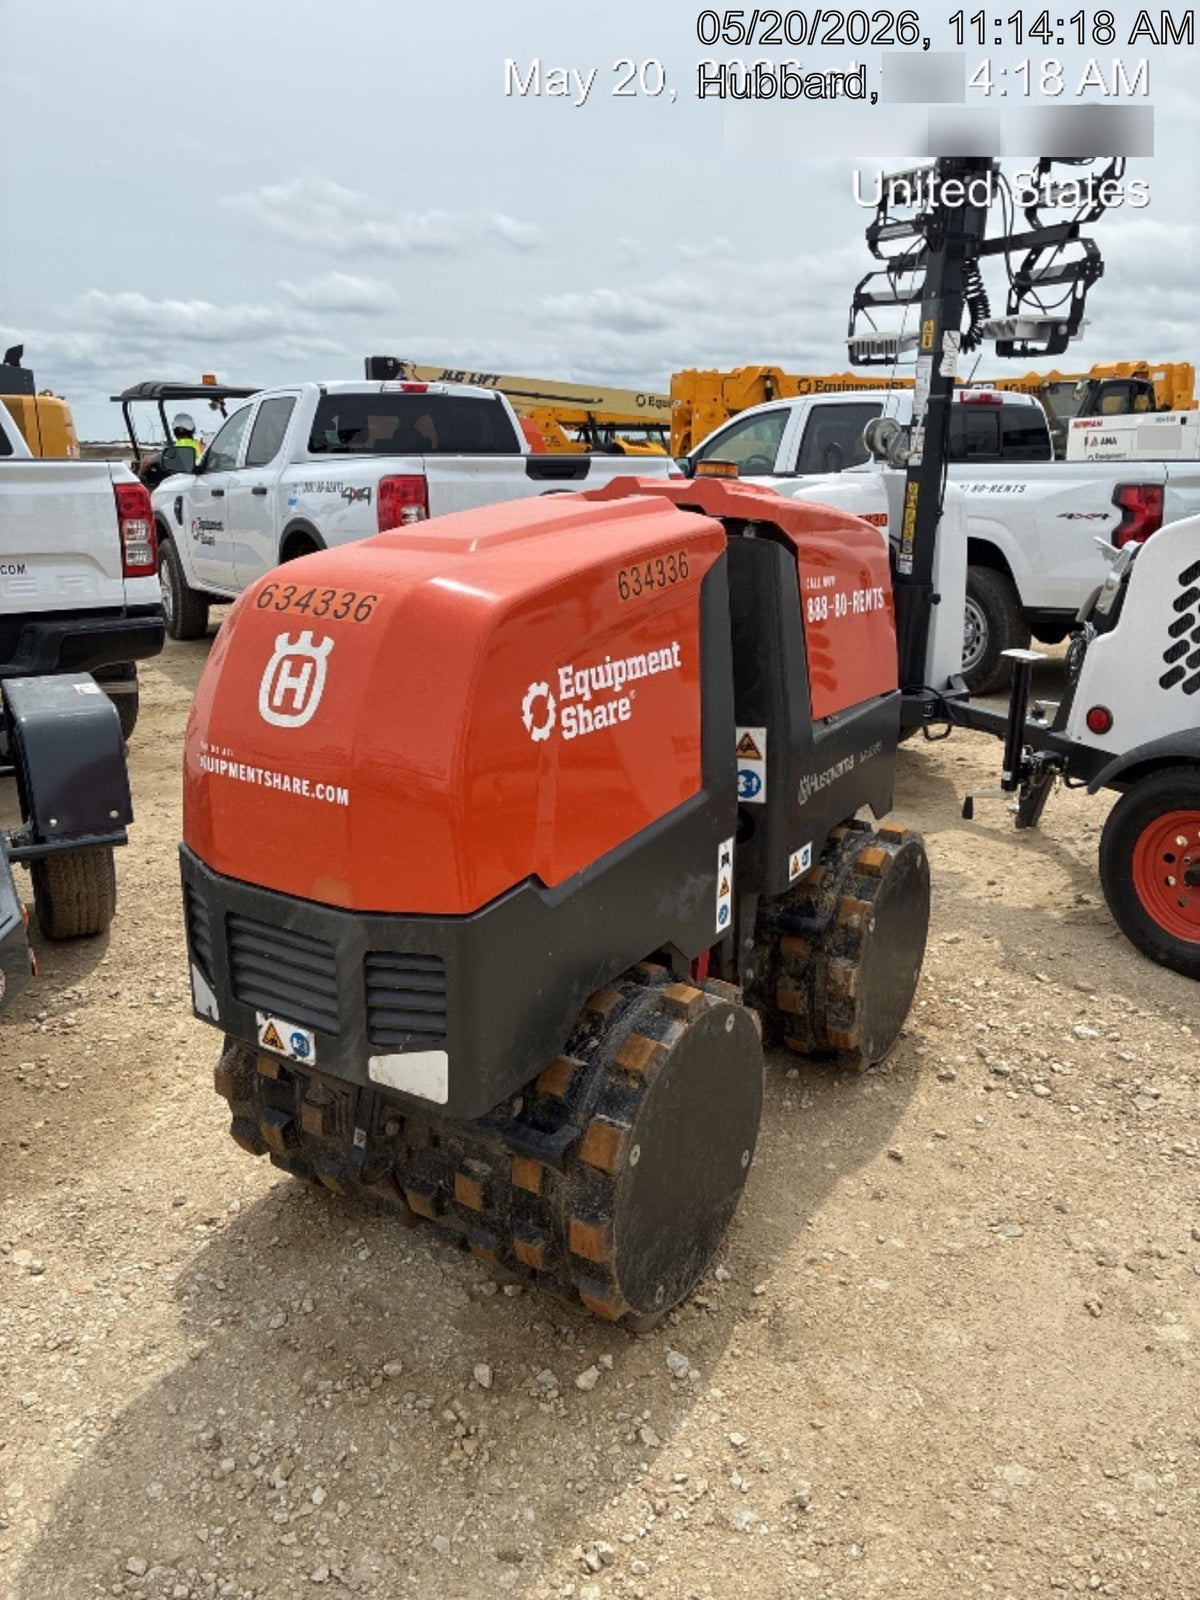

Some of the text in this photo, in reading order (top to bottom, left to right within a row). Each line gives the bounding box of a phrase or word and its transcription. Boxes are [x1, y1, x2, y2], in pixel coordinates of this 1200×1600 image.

[438, 369, 502, 386] JLG LIFT
[618, 551, 690, 600] 634336
[256, 583, 378, 622] 634336
[806, 586, 885, 623] 888-80-RENTS
[558, 641, 682, 701] Equipment
